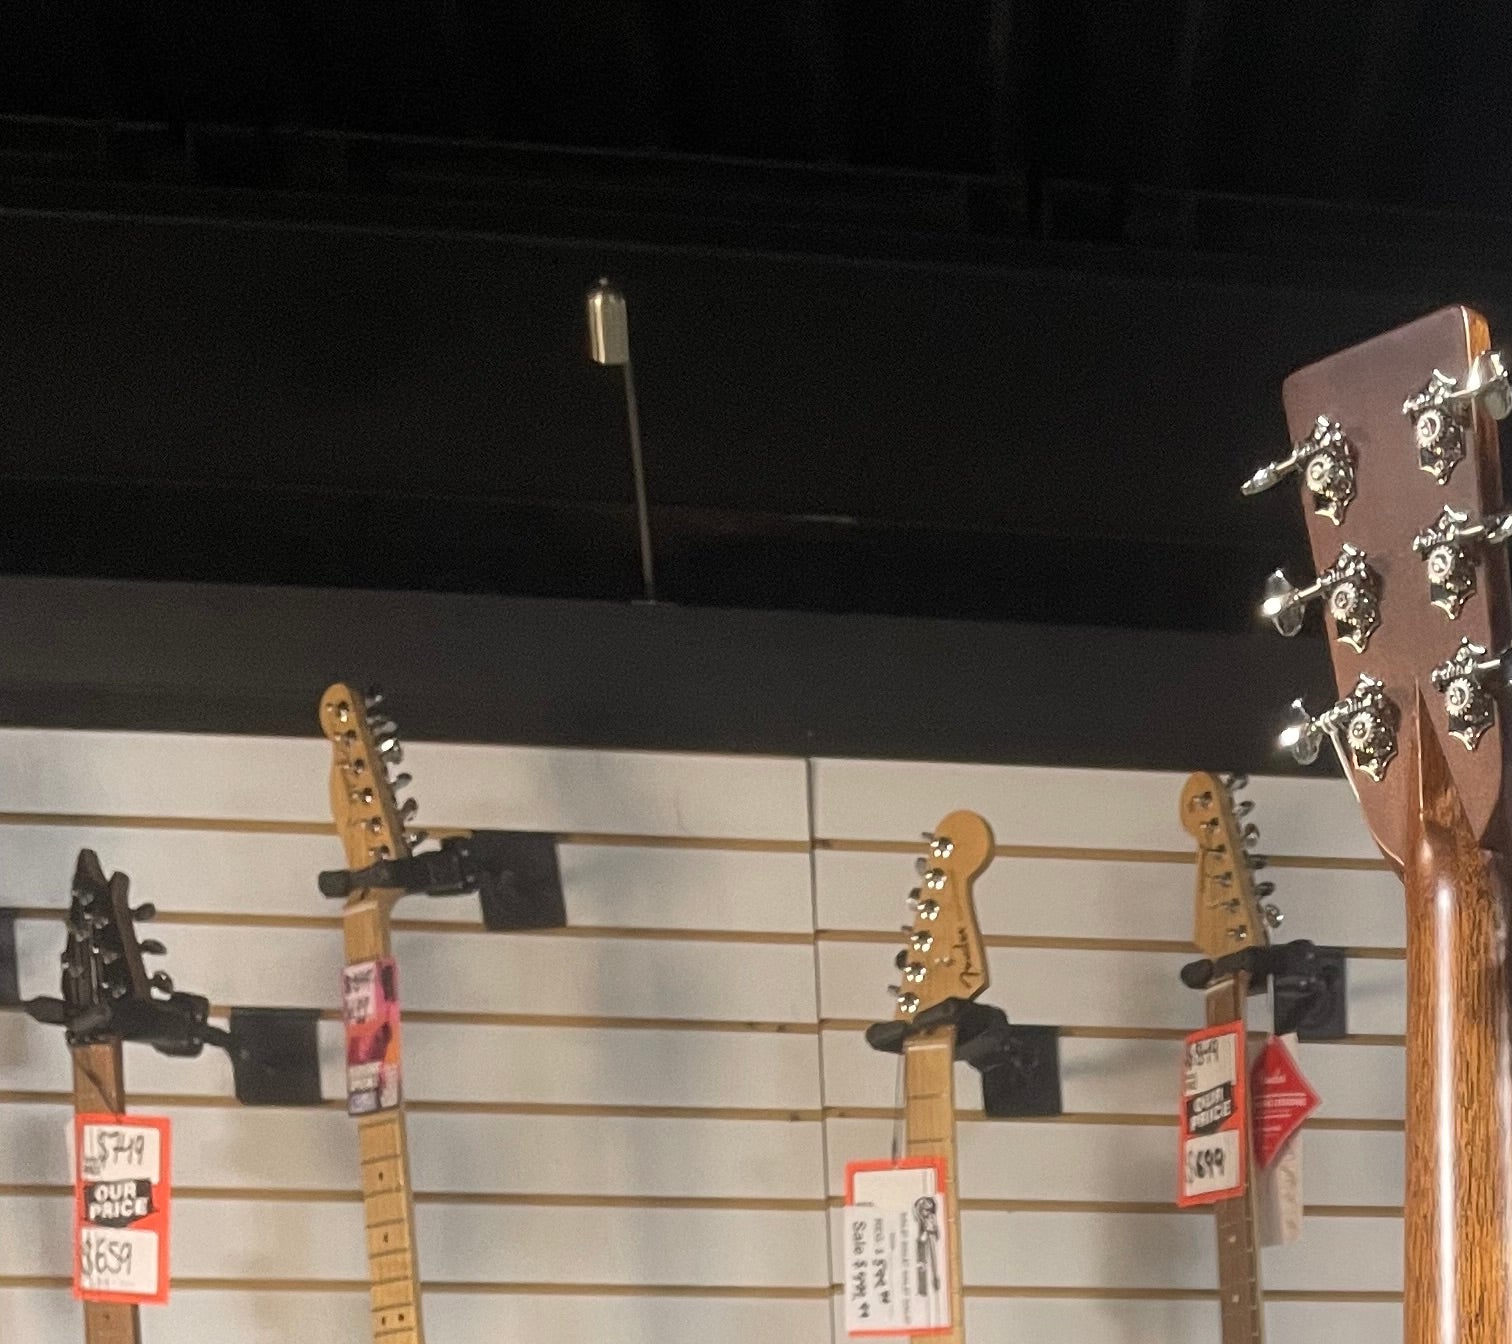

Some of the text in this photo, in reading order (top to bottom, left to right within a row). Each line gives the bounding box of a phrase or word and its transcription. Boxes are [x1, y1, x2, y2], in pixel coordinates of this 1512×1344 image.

[1193, 1086, 1225, 1113] OUR
[1190, 1099, 1232, 1132] PRICE
[94, 1181, 138, 1202] OUR
[89, 1198, 150, 1221] PRICE
[852, 1220, 868, 1256] Sale
